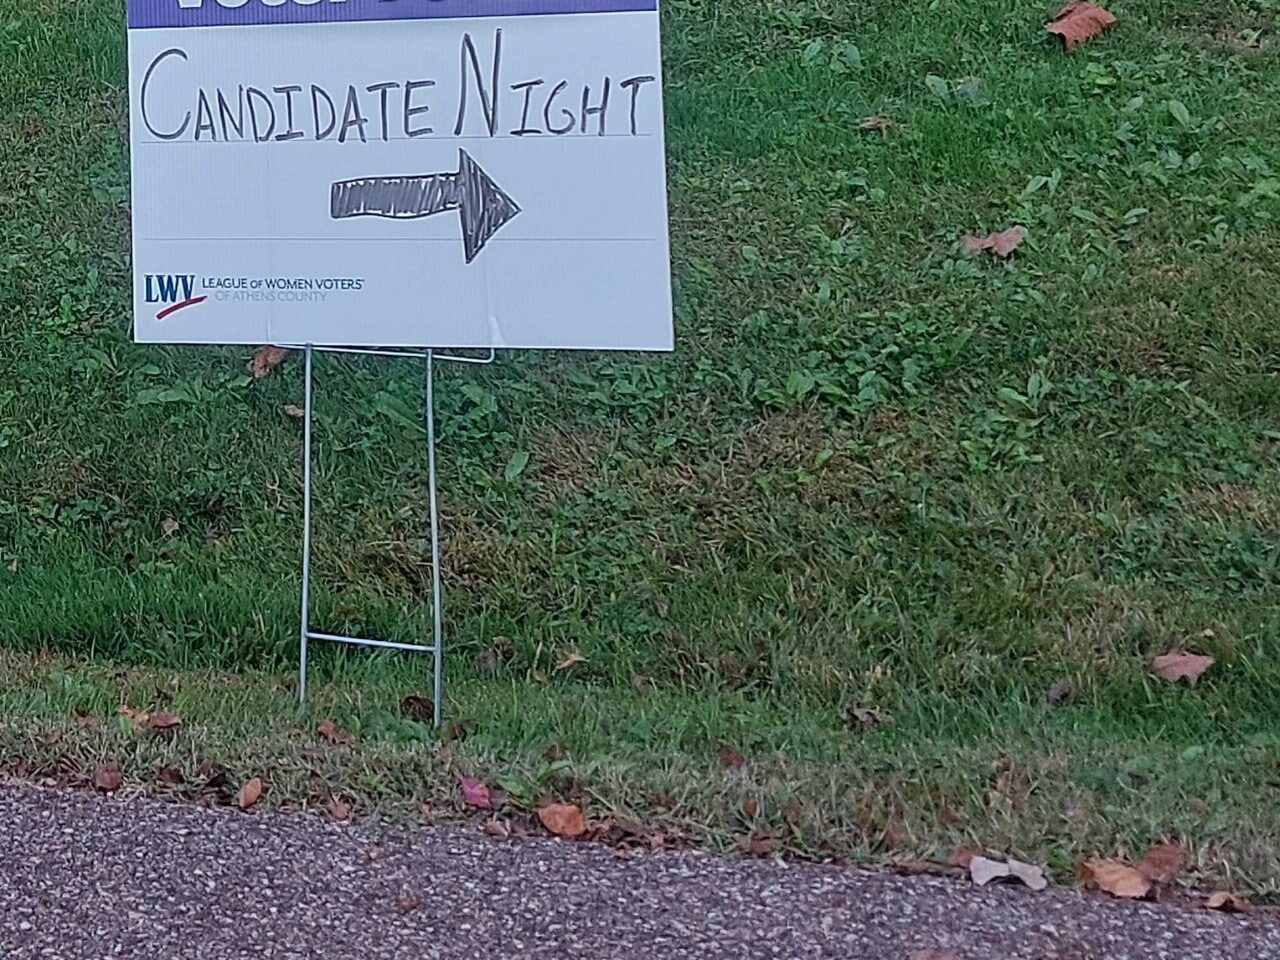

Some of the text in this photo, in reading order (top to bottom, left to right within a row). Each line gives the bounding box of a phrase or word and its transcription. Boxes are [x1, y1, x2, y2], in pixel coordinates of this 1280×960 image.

[140, 28, 655, 144] CANDIDATE NIGHT
[144, 275, 195, 302] LWV
[202, 278, 248, 289] LEAGUE
[265, 278, 313, 289] WOMEN
[215, 291, 328, 302] OF ATHENS COUNTY
